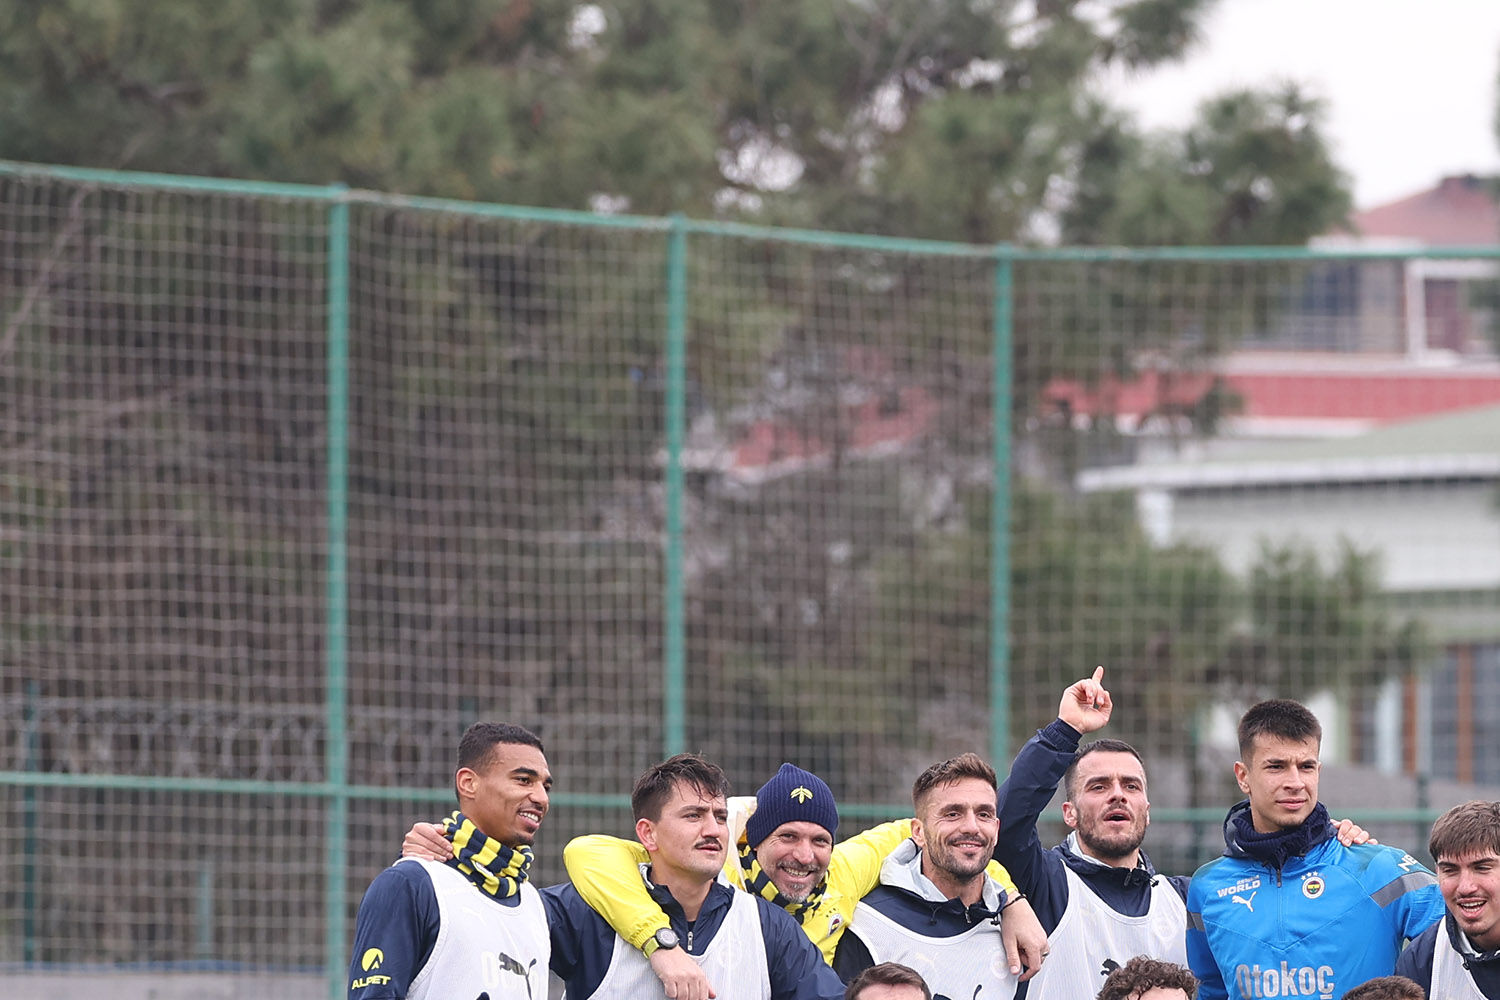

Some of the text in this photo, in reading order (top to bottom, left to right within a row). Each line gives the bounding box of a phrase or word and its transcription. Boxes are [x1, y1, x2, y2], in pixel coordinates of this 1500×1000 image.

[1217, 879, 1261, 898] WORLD
[351, 974, 391, 990] ALPET
[1236, 961, 1335, 1000] Otokoç
